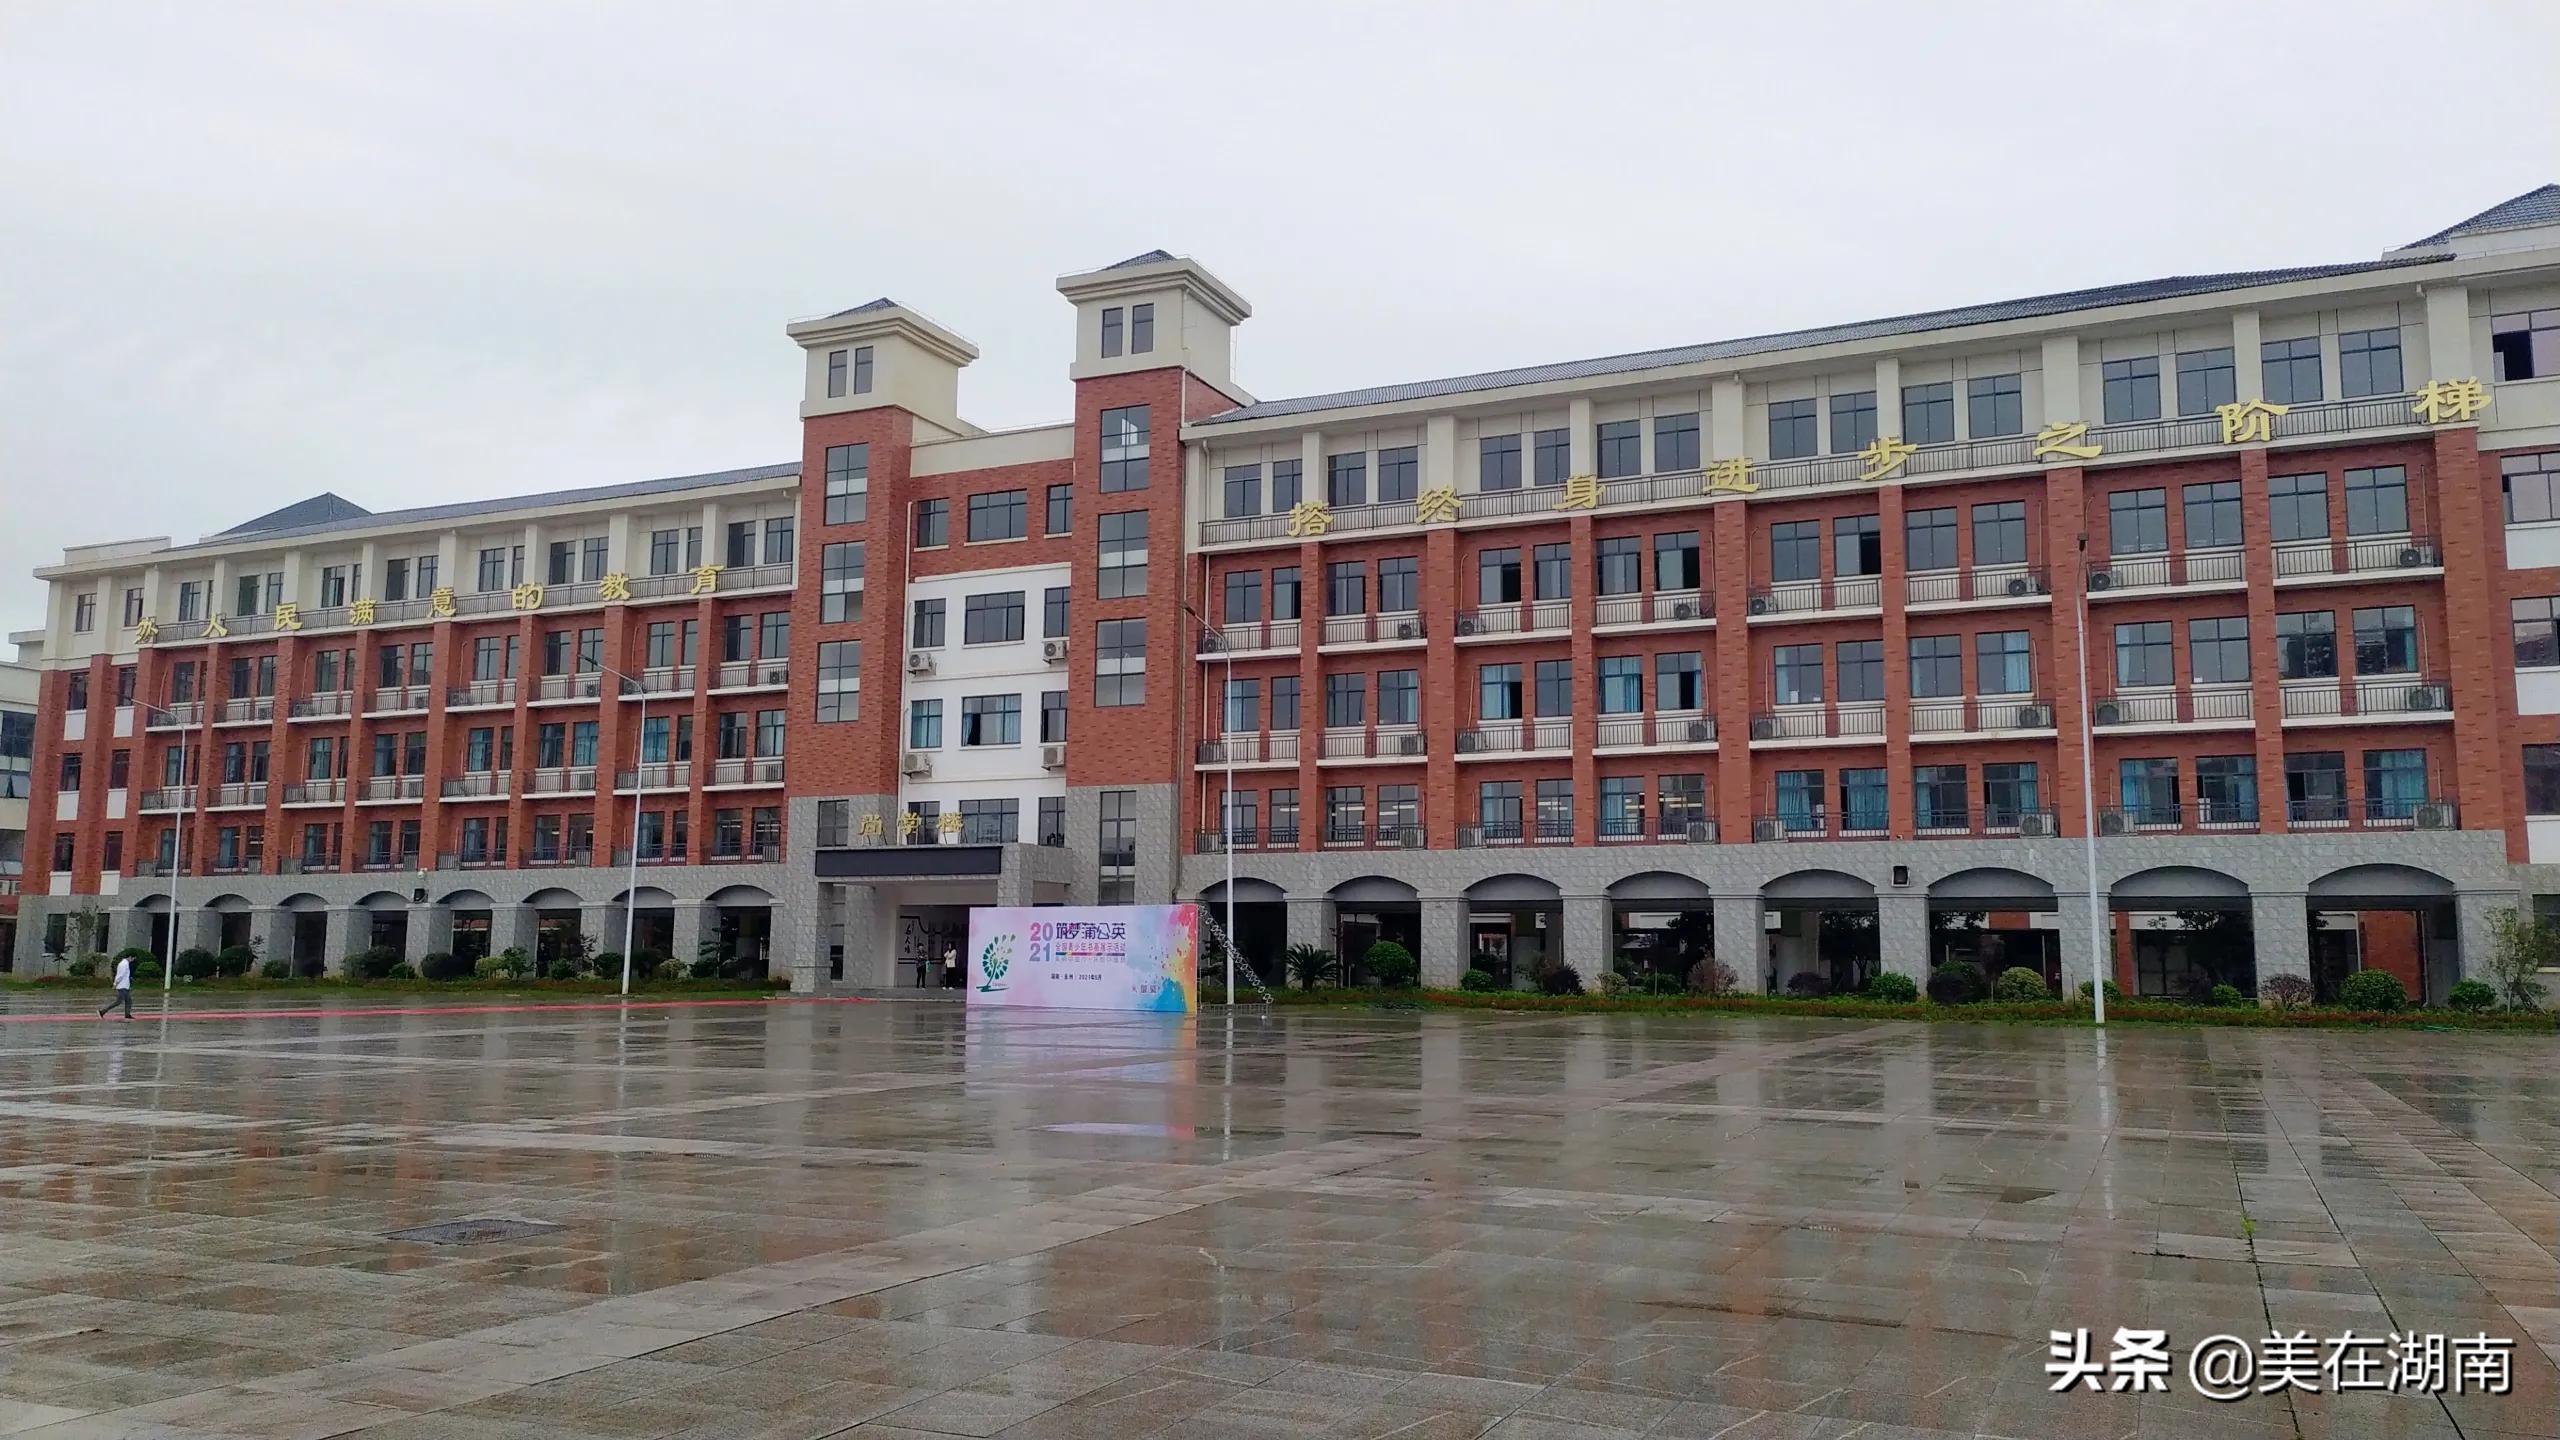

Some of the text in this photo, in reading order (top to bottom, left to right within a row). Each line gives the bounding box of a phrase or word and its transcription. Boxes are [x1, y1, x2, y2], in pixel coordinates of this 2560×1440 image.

[1288, 376, 2492, 537] 搭终身进步之阶梯
[134, 564, 724, 644] 办人民满意的教育
[1030, 922, 1053, 941] 20
[1056, 922, 1126, 939] 筑梦蒲公英
[1029, 943, 1050, 961] 21
